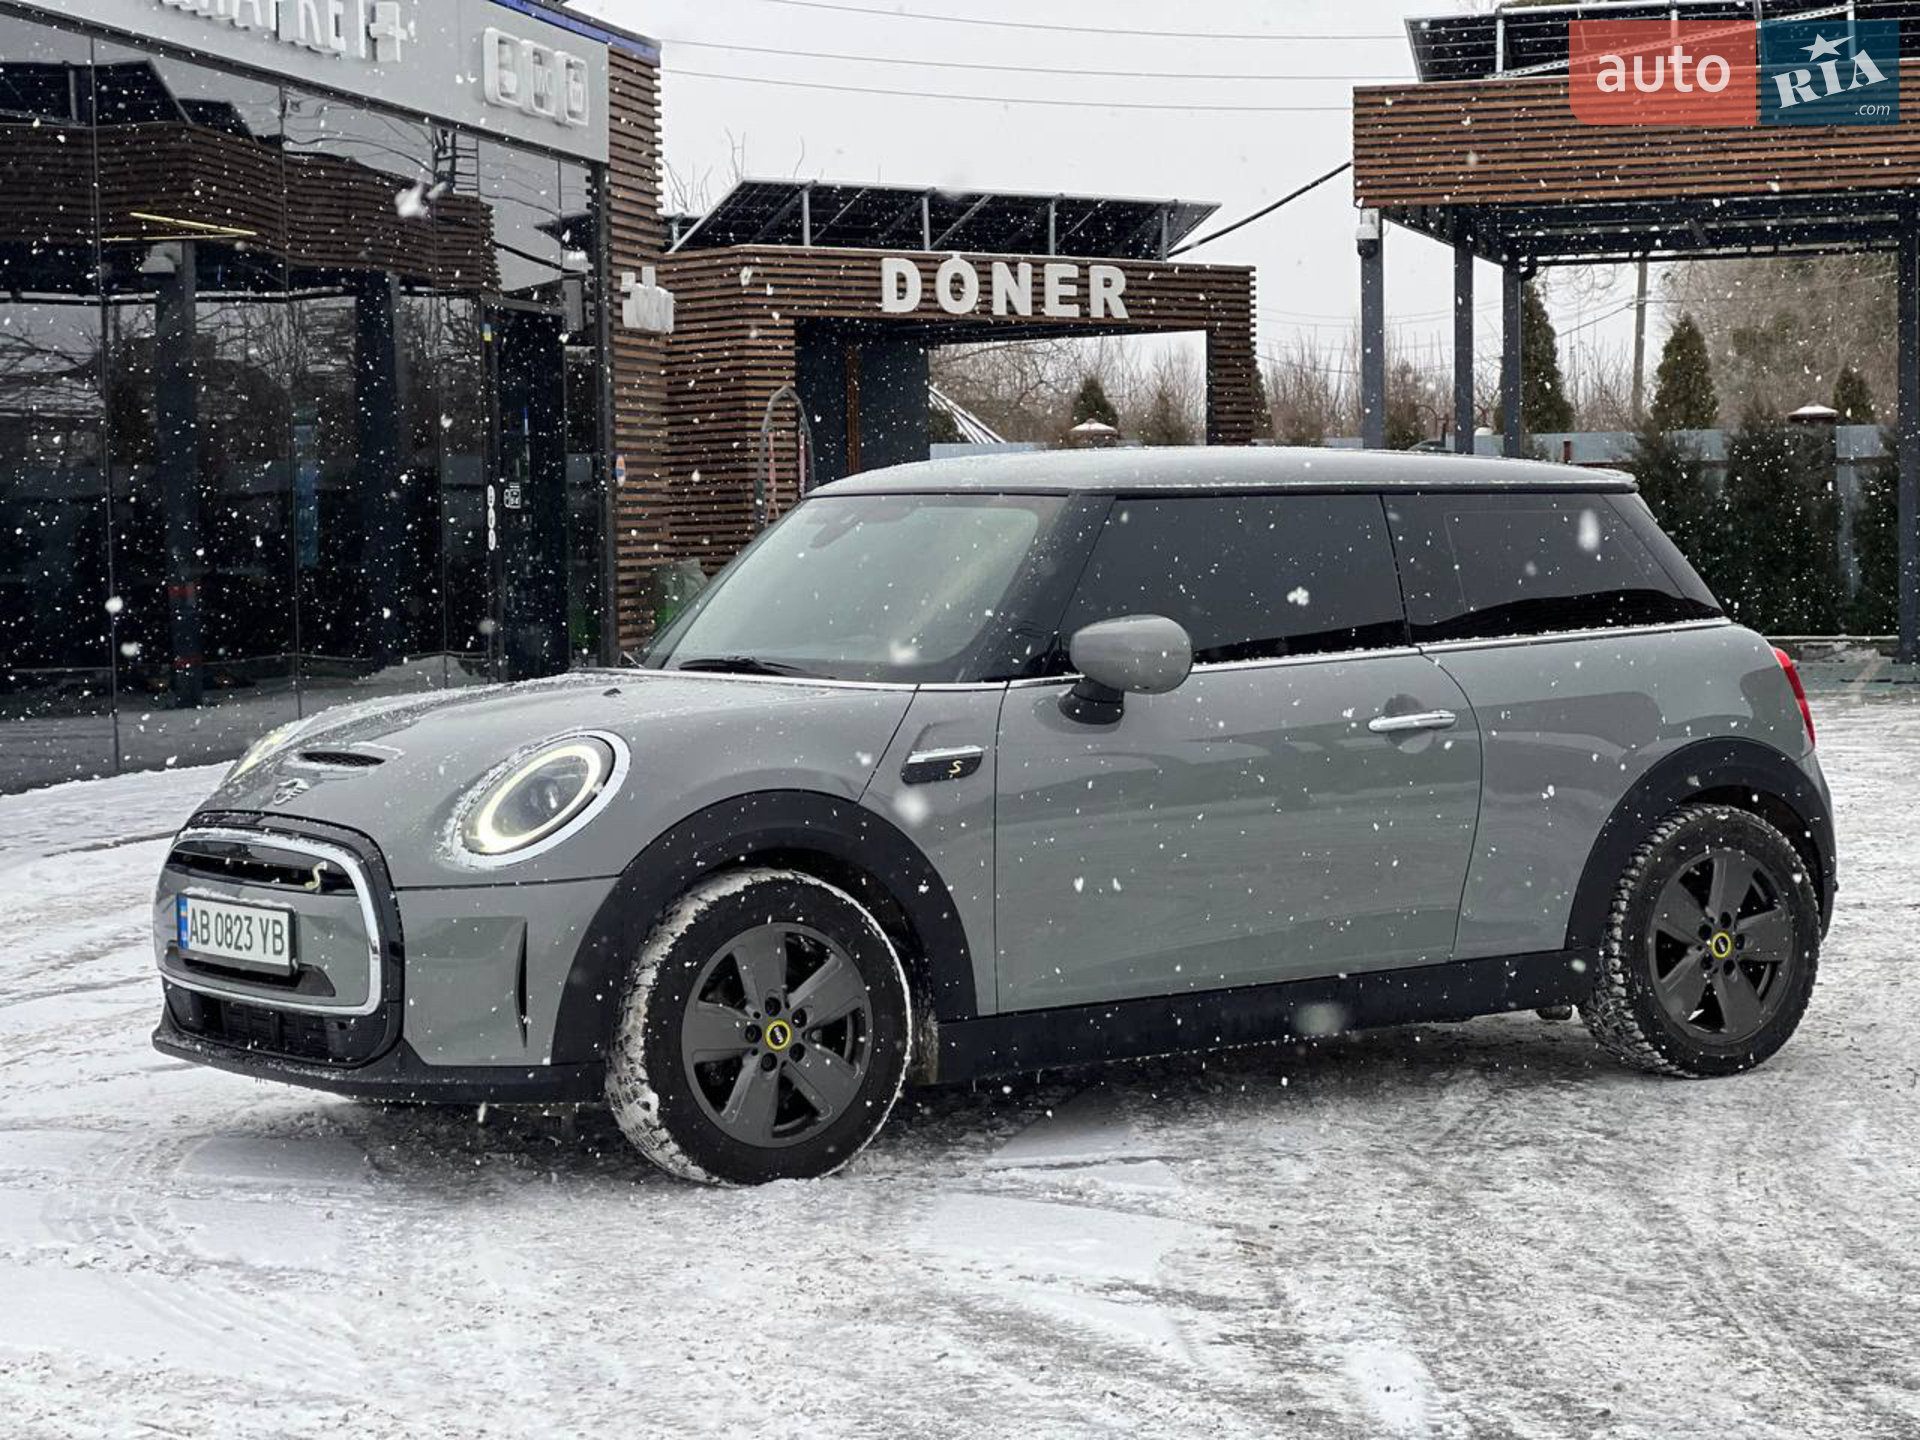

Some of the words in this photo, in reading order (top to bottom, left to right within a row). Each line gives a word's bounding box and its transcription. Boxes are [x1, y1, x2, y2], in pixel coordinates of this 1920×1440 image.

[948, 760, 964, 774] S
[303, 861, 328, 889] S
[190, 908, 211, 945] AB
[215, 912, 253, 951] 0823
[259, 917, 285, 956] YB
